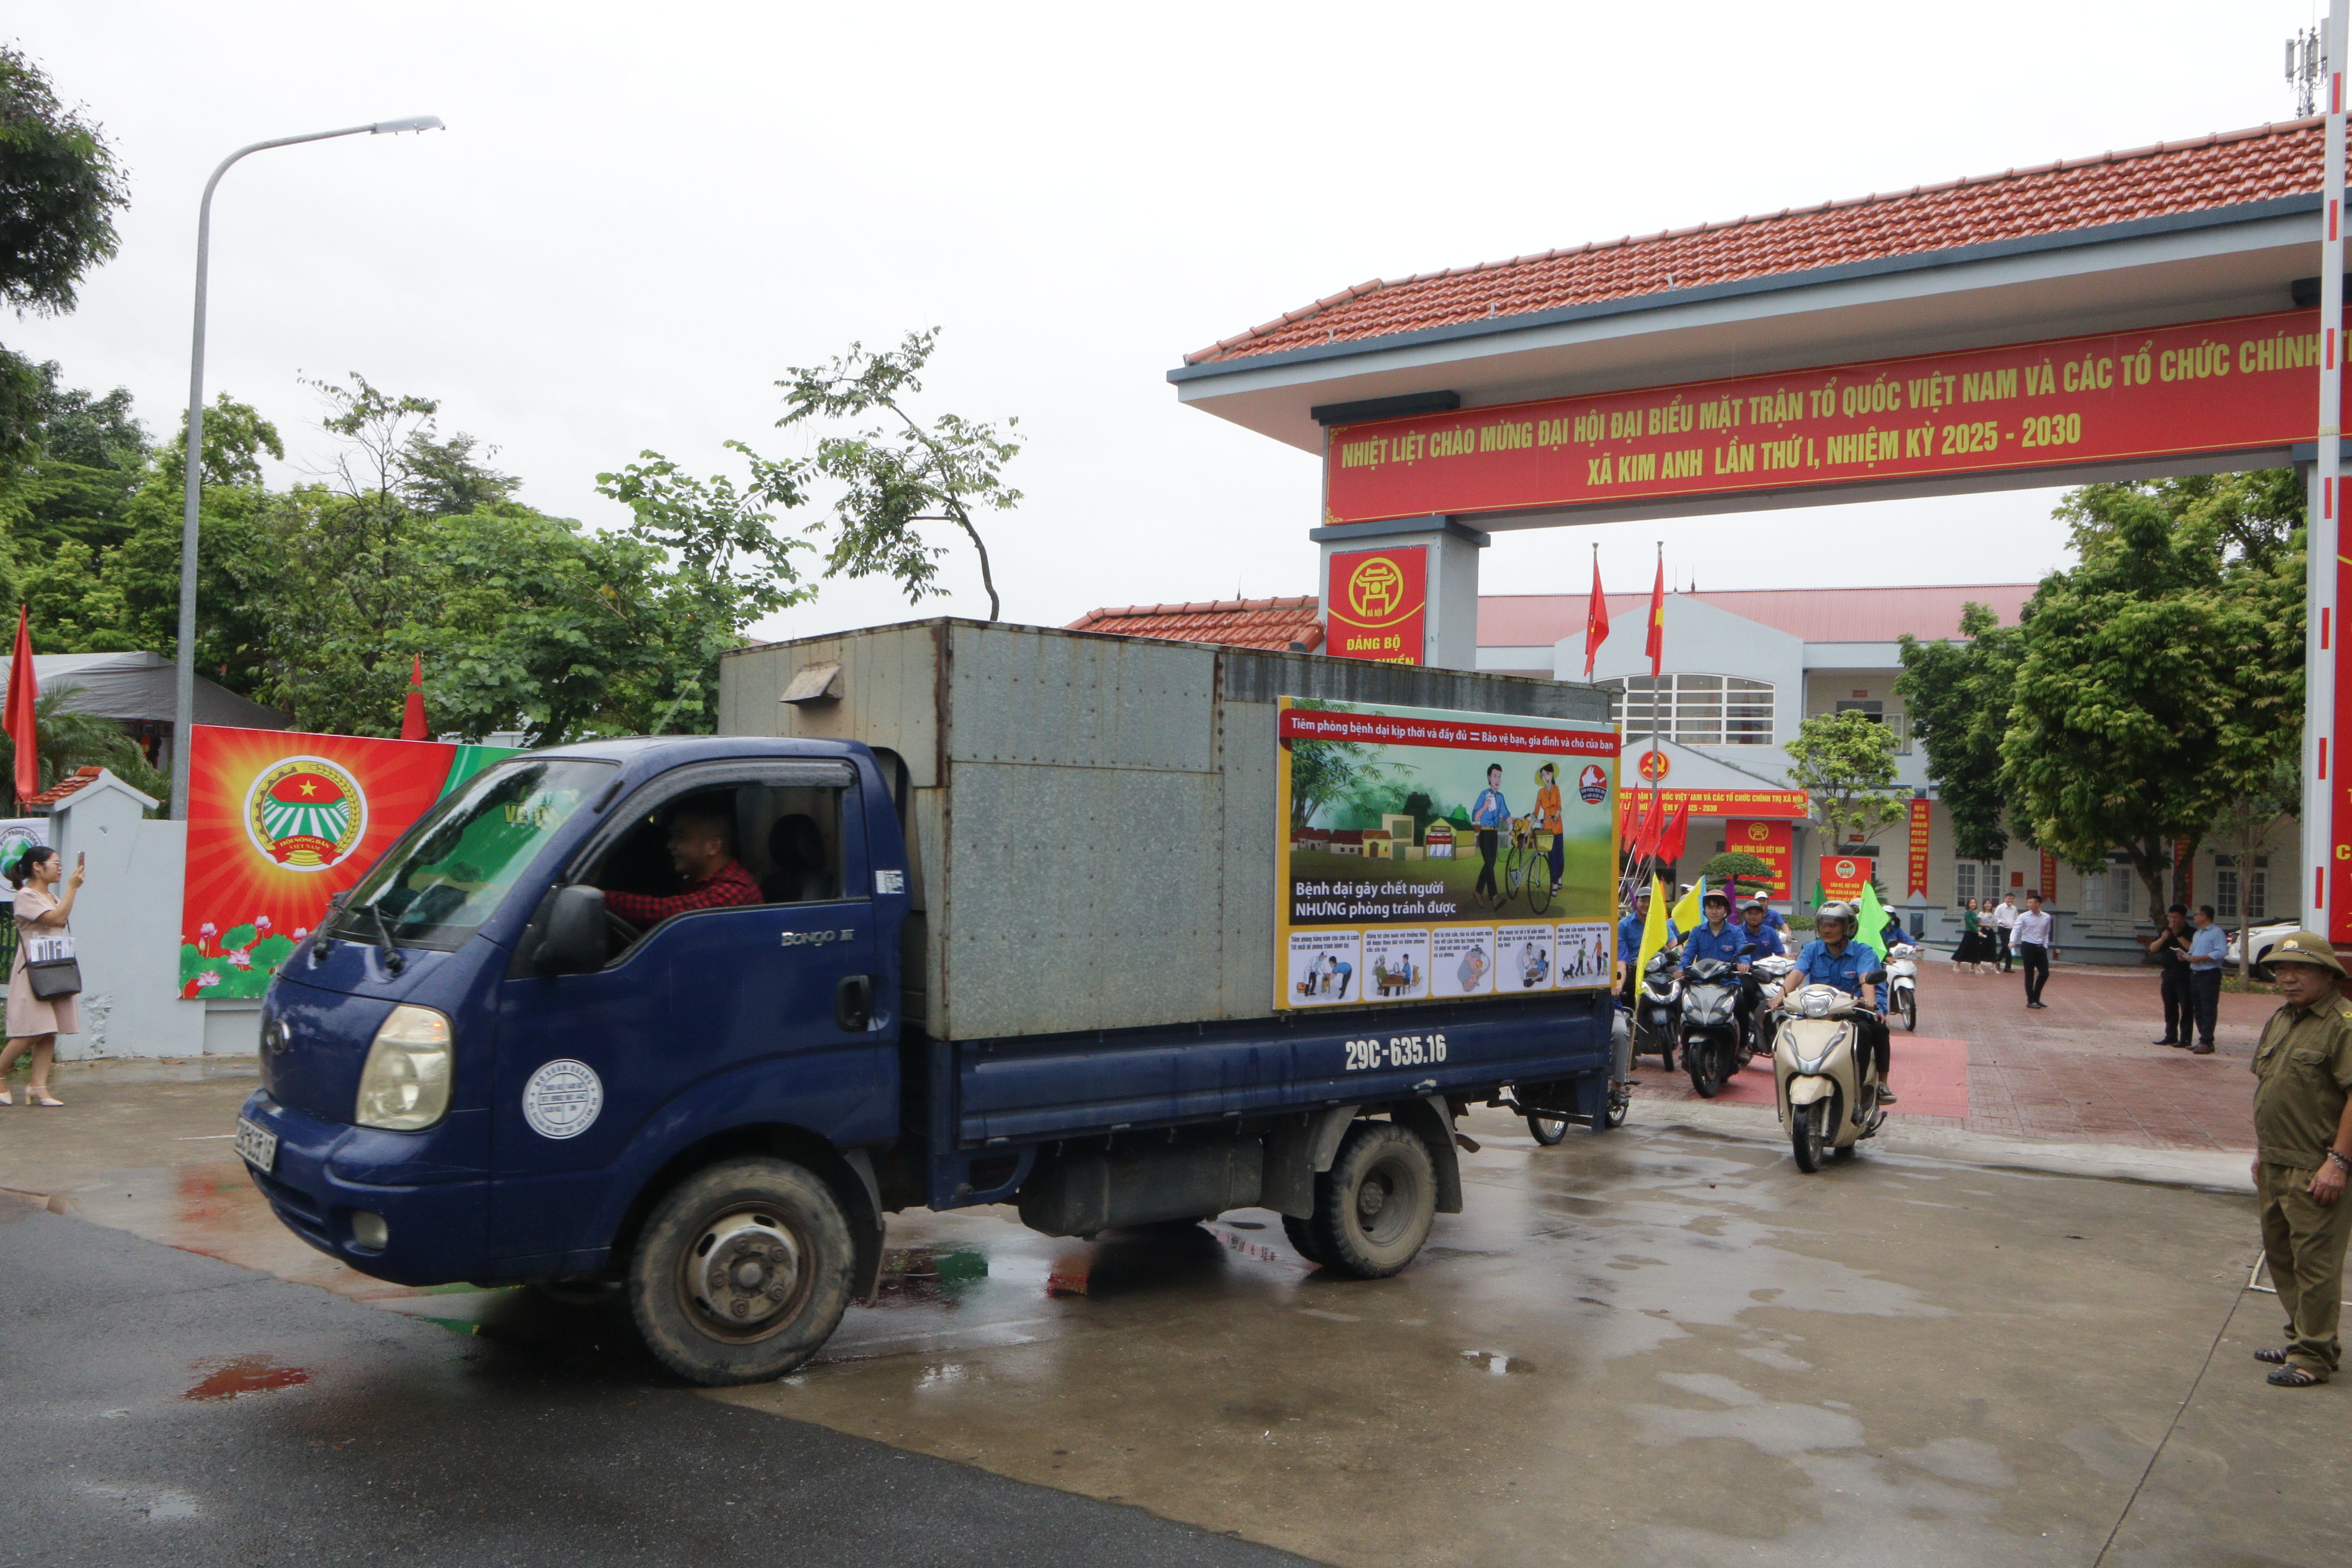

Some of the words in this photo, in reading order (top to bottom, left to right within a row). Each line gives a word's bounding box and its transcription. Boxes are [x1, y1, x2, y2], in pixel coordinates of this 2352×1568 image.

[1342, 436, 1387, 470] NHIỆT
[1392, 431, 1425, 466] LIỆT
[1430, 425, 1475, 458] CHÀO
[1481, 420, 1533, 452] MỪNG
[1538, 419, 1568, 450] ĐẠI
[1574, 409, 1605, 446] HỘI
[1611, 410, 1642, 443] ĐẠI
[1649, 395, 1693, 435] BIỂU
[1700, 395, 1743, 435] MẶT
[1750, 388, 1803, 427] TRẬN
[1810, 377, 1837, 417] TỔ
[1843, 377, 1900, 417] QUỐC
[1909, 371, 1956, 413] VIỆT
[1963, 368, 2017, 403] NAM
[2026, 358, 2056, 396] VÀ
[2064, 354, 2112, 392] CÁC
[2122, 341, 2152, 386] TỔ
[2160, 340, 2229, 381] CHỨC
[2239, 331, 2321, 373] CHÍNH
[1587, 453, 1613, 486] XÃ
[1618, 453, 1656, 483] KIM
[1661, 449, 1703, 479] ANH
[1715, 436, 1755, 475] LẦN
[1761, 433, 1803, 470] THỨ
[1807, 444, 1820, 469] I,
[1827, 426, 1899, 468] NHIỆM
[1906, 420, 1935, 458] KỲ
[1942, 421, 1998, 455] 2025
[2022, 413, 2080, 447] 2030
[1367, 609, 1374, 617] HÀ
[1374, 607, 1383, 618] NỘI
[1346, 634, 1380, 651] ĐẢNG
[1384, 634, 1401, 651] BỘ
[1292, 717, 1315, 730] Tiêm
[1317, 720, 1348, 734] phòng
[1350, 721, 1373, 736] bệnh
[1376, 724, 1389, 738] dại
[1391, 724, 1405, 739] kịp
[1407, 726, 1425, 737] thời
[1427, 728, 1437, 739] và
[1456, 730, 1467, 740] đủ
[1482, 731, 1497, 743] Bảo
[1499, 733, 1508, 746] vệ
[1510, 733, 1527, 746] bạn,
[1528, 735, 1541, 747] gia
[1542, 736, 1559, 747] đình
[1561, 737, 1570, 747] và
[1572, 737, 1584, 748] chó
[1586, 739, 1598, 749] của
[1600, 739, 1613, 752] bạn
[1662, 791, 1674, 801] UỐC
[1675, 792, 1687, 802] VIỆT
[1704, 792, 1711, 801] VÀ
[1713, 792, 1724, 801] CÁC
[1726, 792, 1734, 801] TỔ
[1735, 793, 1750, 802] CHỨC
[1752, 793, 1770, 802] CHÍNH
[1772, 795, 1781, 803] TRỊ
[1296, 881, 1329, 899] Bệnh
[1332, 881, 1353, 899] dại
[1355, 881, 1378, 898] gây
[1381, 880, 1407, 894] chết
[1410, 881, 1443, 897] người
[1296, 901, 1346, 916] NHƯNG
[1349, 901, 1390, 918] phòng
[1393, 901, 1425, 914] tránh
[1427, 901, 1456, 916] được
[1345, 1034, 1446, 1070] 29C-635.16
